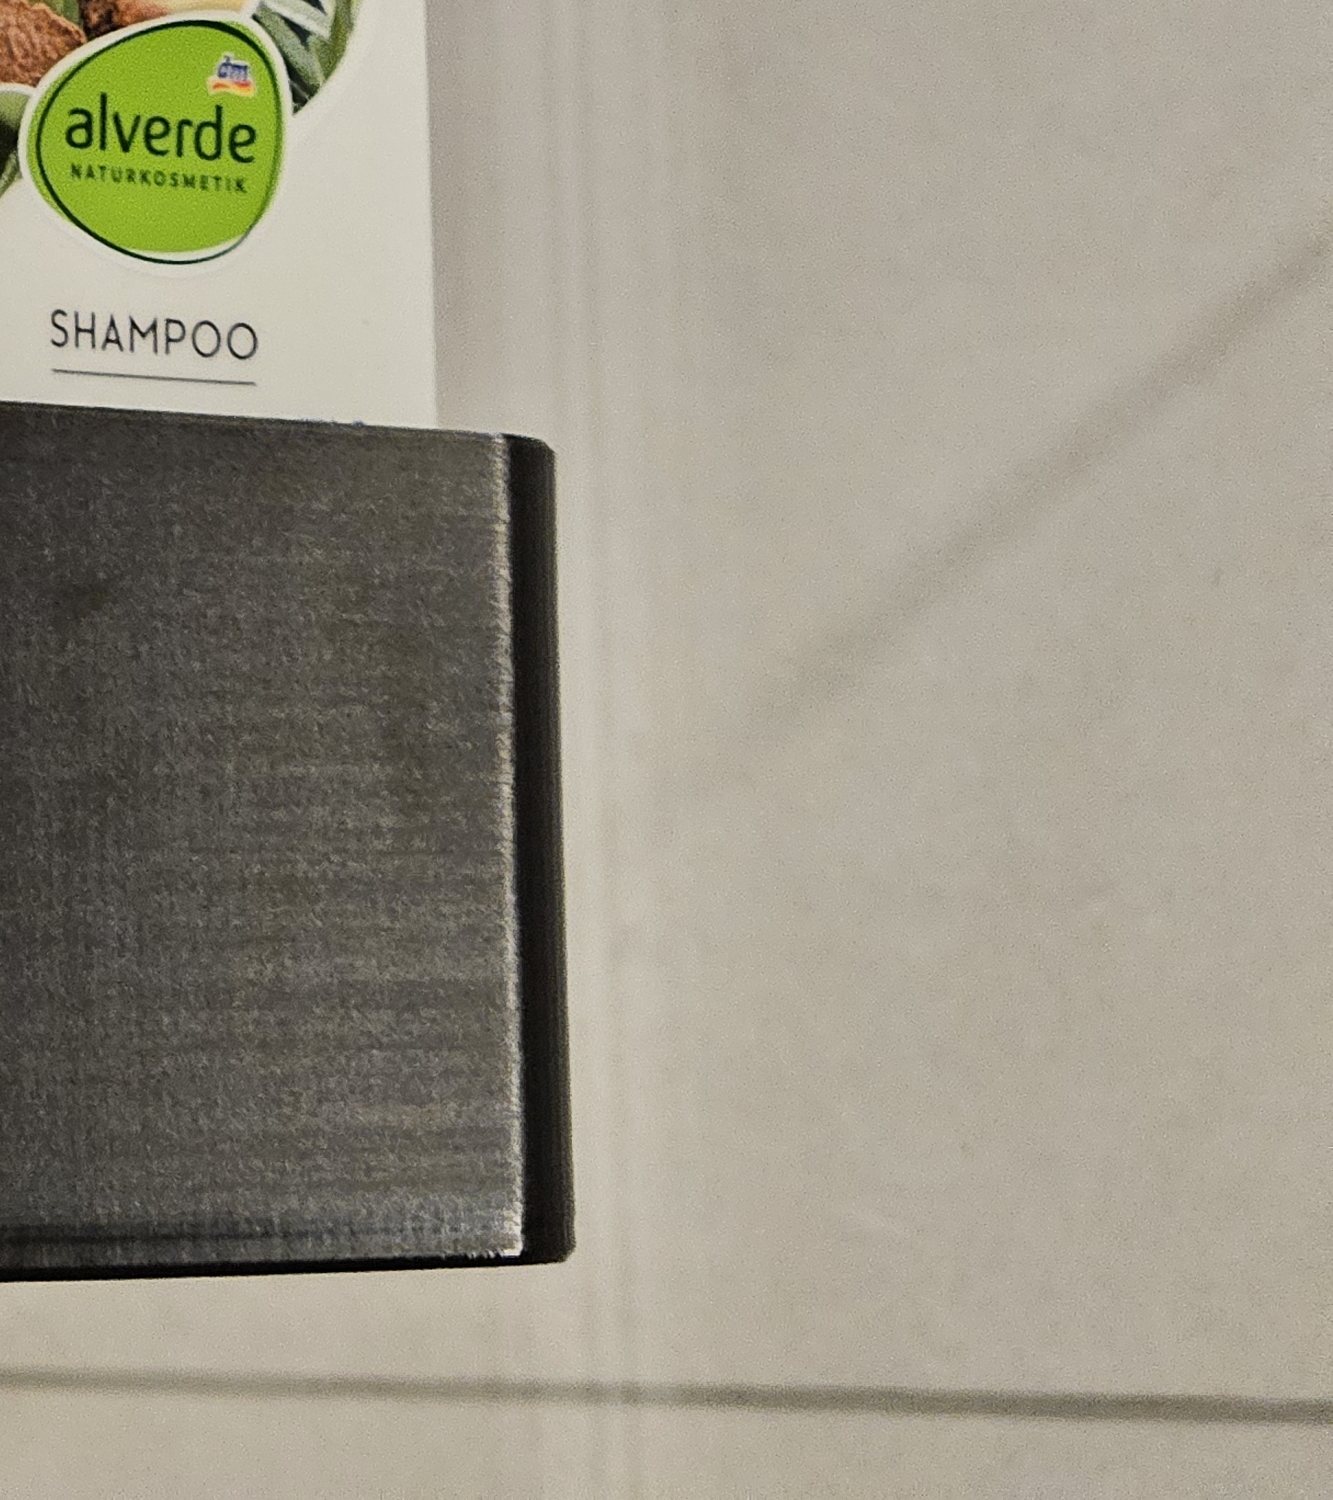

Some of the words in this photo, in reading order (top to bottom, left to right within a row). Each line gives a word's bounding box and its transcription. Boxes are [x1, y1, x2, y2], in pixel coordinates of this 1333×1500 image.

[64, 92, 257, 164] alverde
[69, 163, 248, 194] NATURKOSMETIK
[50, 309, 259, 361] SHAMPOO
